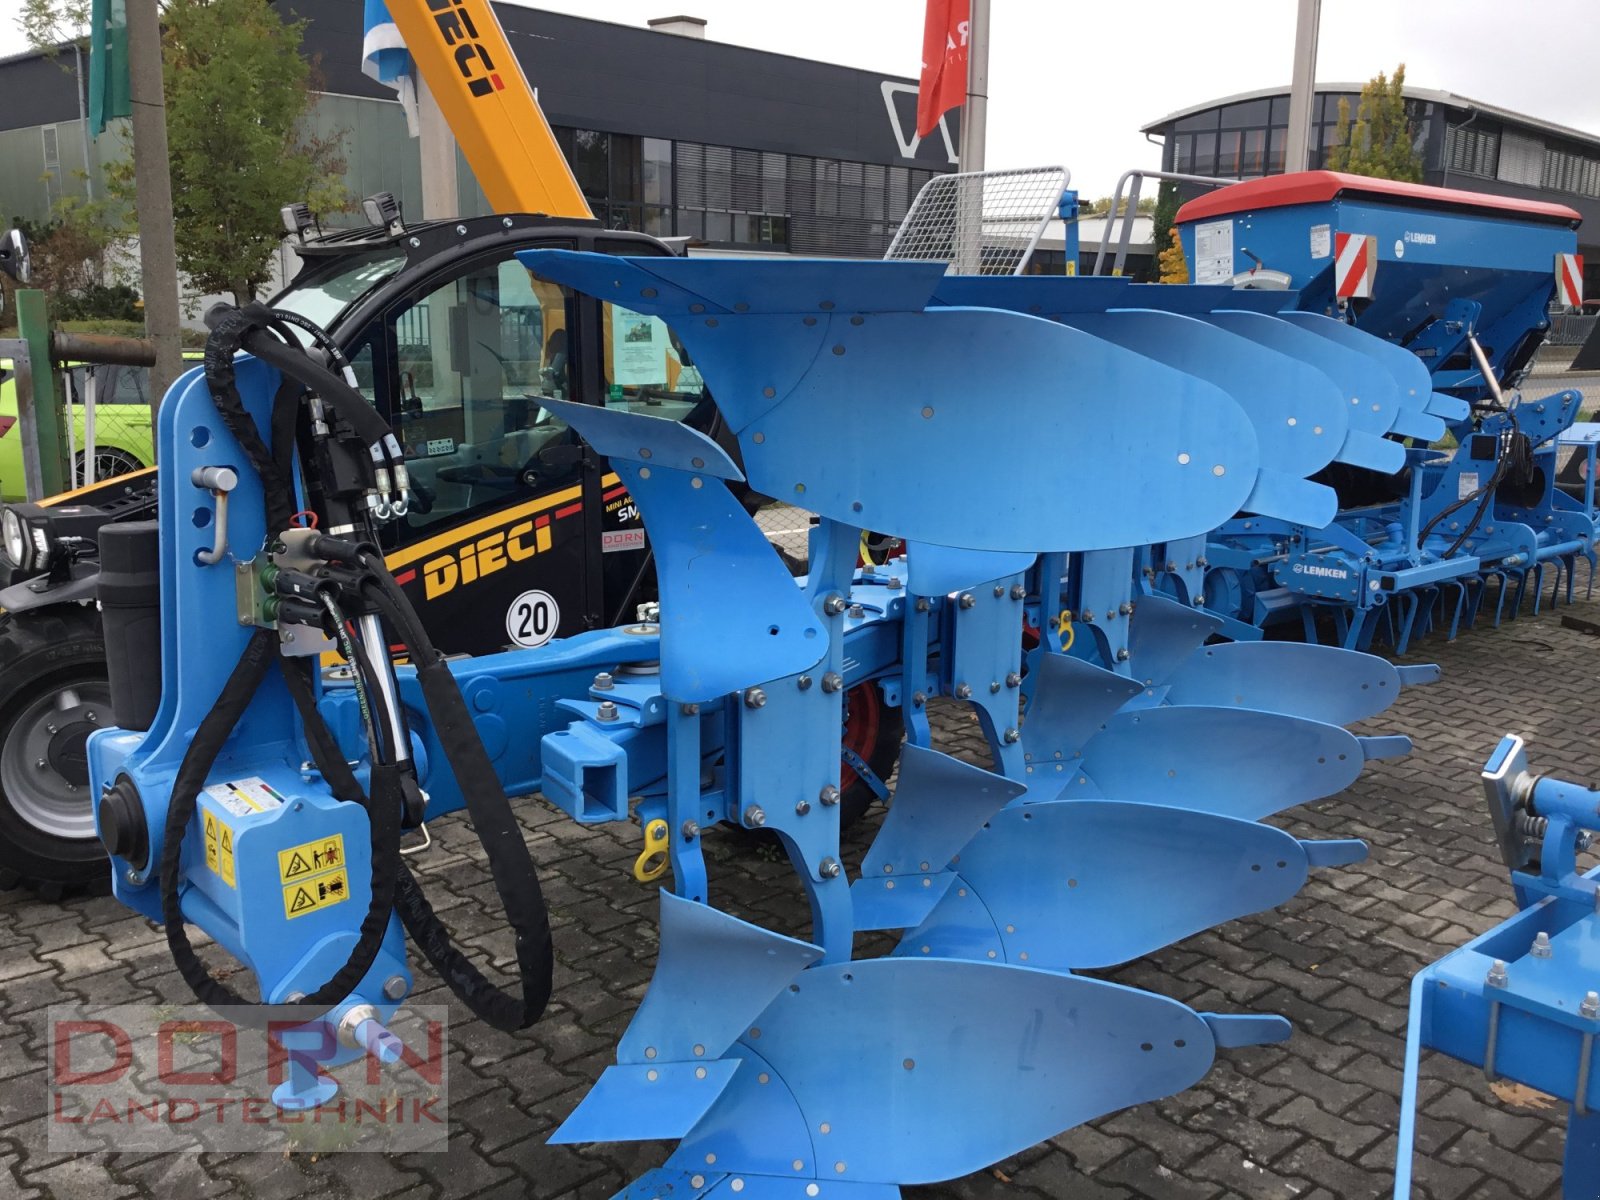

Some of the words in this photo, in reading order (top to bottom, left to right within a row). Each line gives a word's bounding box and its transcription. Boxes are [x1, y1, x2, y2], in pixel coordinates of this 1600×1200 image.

[603, 532, 643, 545] DORN
[423, 514, 552, 601] DIECI
[1303, 565, 1347, 580] LEMKEN
[518, 601, 549, 638] 20
